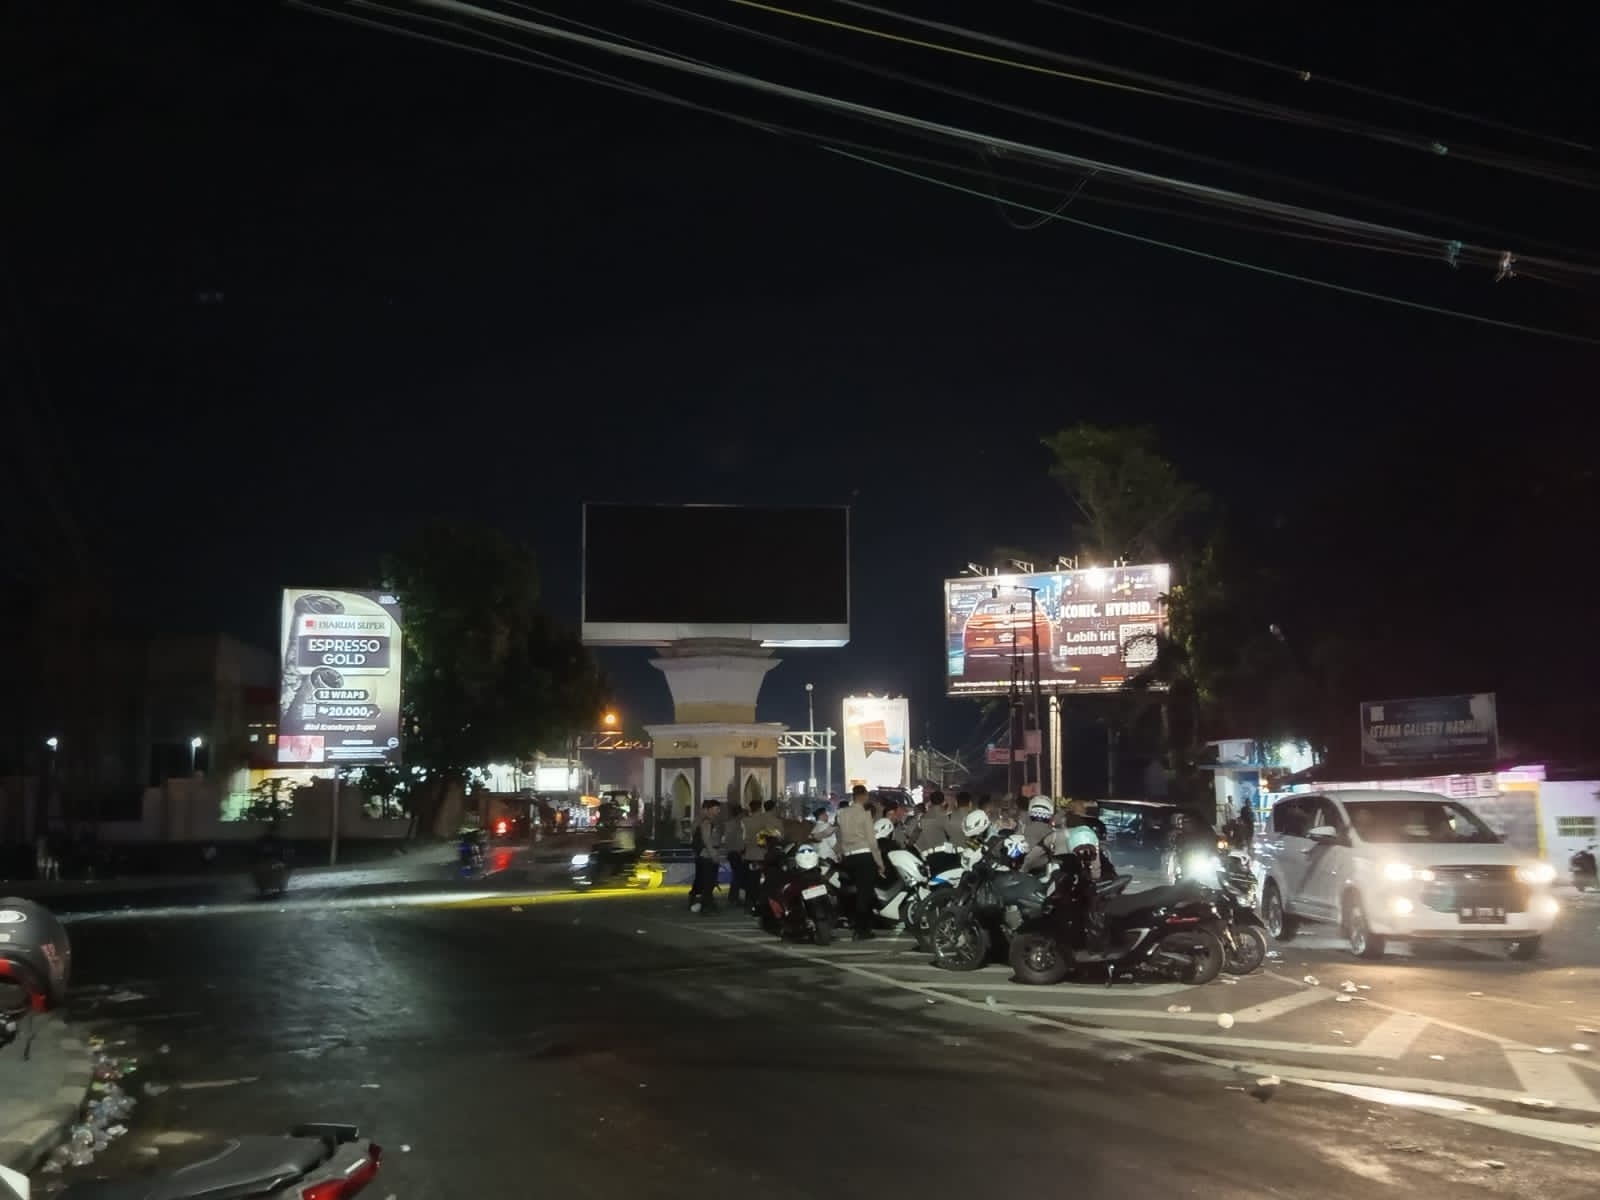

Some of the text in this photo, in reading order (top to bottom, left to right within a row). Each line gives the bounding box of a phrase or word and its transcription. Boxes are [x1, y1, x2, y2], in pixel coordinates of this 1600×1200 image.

[1105, 601, 1154, 617] HYBRID.
[357, 621, 385, 630] SUPER
[1066, 630, 1116, 643] Lebih Irit
[308, 639, 380, 653] ESPRESSO
[1059, 644, 1118, 657] Bertenaga
[322, 653, 366, 665] GOLD
[331, 691, 365, 699] WRAPS
